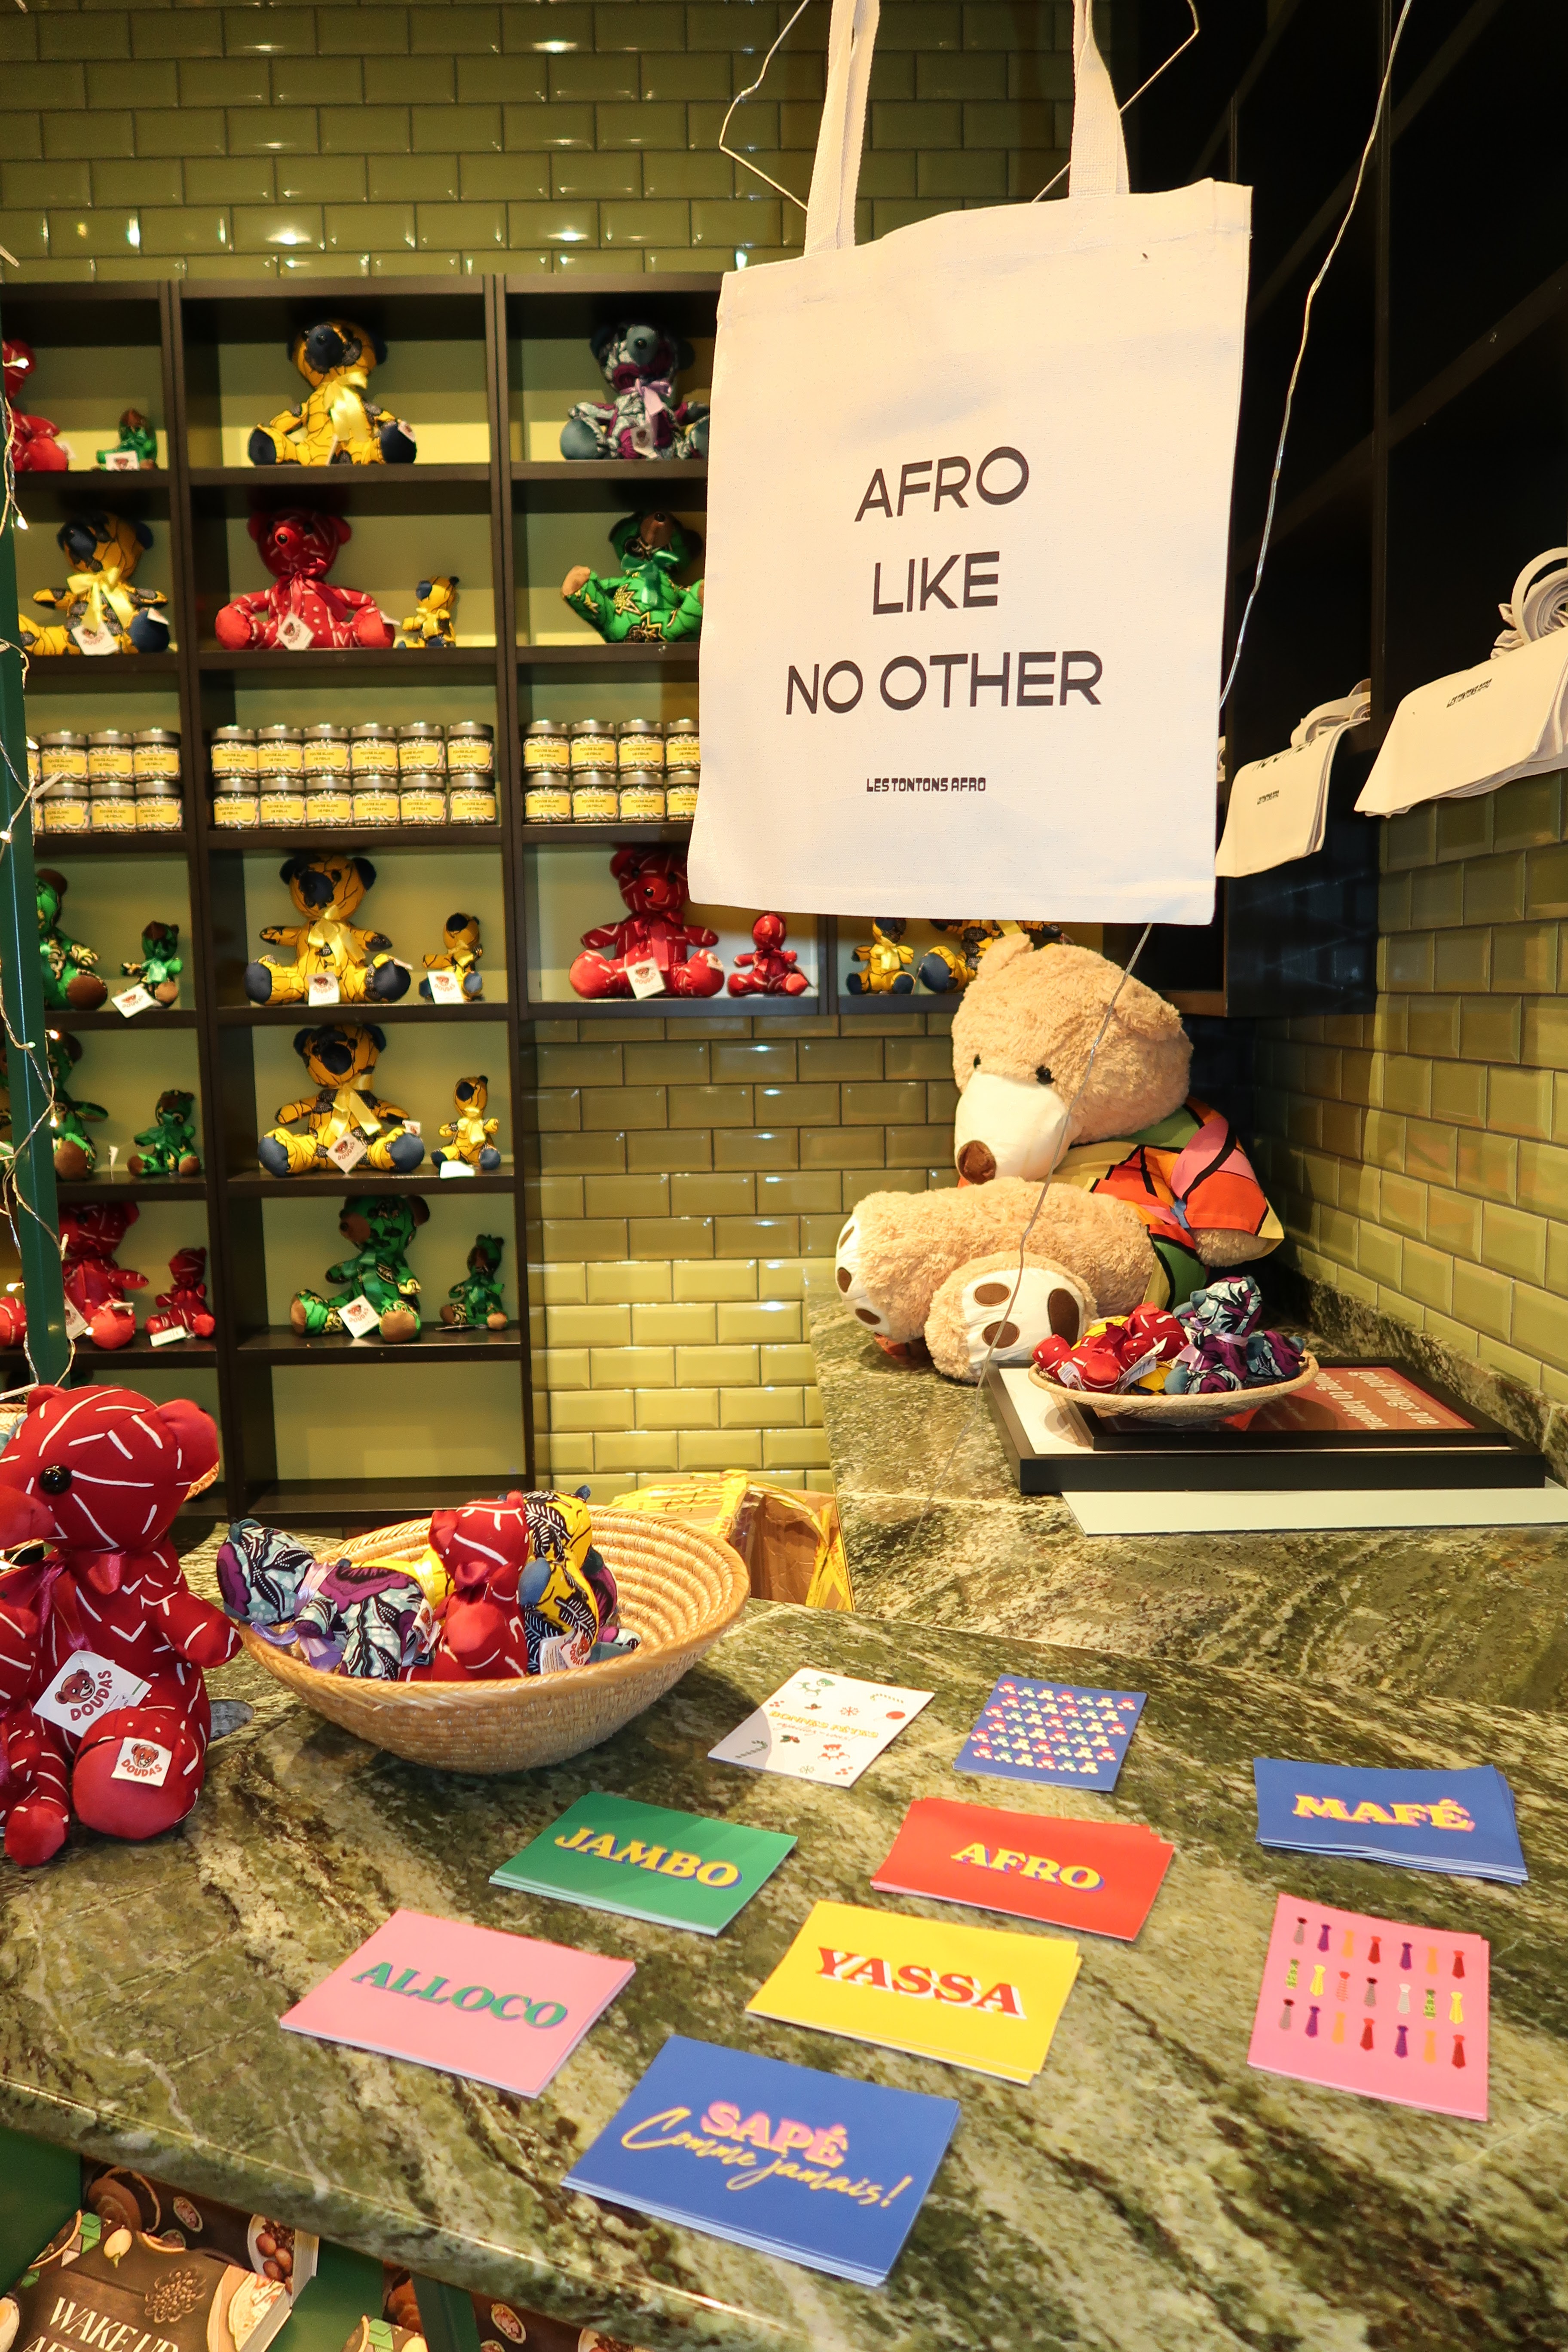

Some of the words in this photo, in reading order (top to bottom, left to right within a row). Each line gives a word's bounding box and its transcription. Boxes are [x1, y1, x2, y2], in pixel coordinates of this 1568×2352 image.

[854, 446, 1029, 522] AFRO
[873, 551, 1000, 615] LIKE
[786, 660, 863, 715] NO
[880, 650, 1103, 711] OTHER
[867, 778, 889, 792] LES
[891, 778, 948, 792] TONTONS
[951, 777, 986, 792] AFRO
[1329, 1391, 1354, 1400] to
[1338, 1400, 1390, 1430] happen.
[1348, 1372, 1397, 1387] good
[1376, 1389, 1420, 1410] things
[1406, 1412, 1439, 1424] are
[570, 1642, 584, 1666] DOUDAS
[70, 1670, 113, 1721] DOUDAS
[121, 1758, 162, 1777] DOUDAS
[1292, 1794, 1475, 1832] MAFÉ
[554, 1827, 743, 1889] JAMBO
[950, 1842, 1105, 1892] AFRO
[351, 1962, 568, 2029] ALLOCO
[816, 1947, 1027, 2020] YASSA
[621, 2106, 756, 2166] Comme
[726, 2152, 913, 2208] jamais!
[701, 2101, 848, 2168] SAPÉ
[49, 2297, 139, 2352] WAKE
